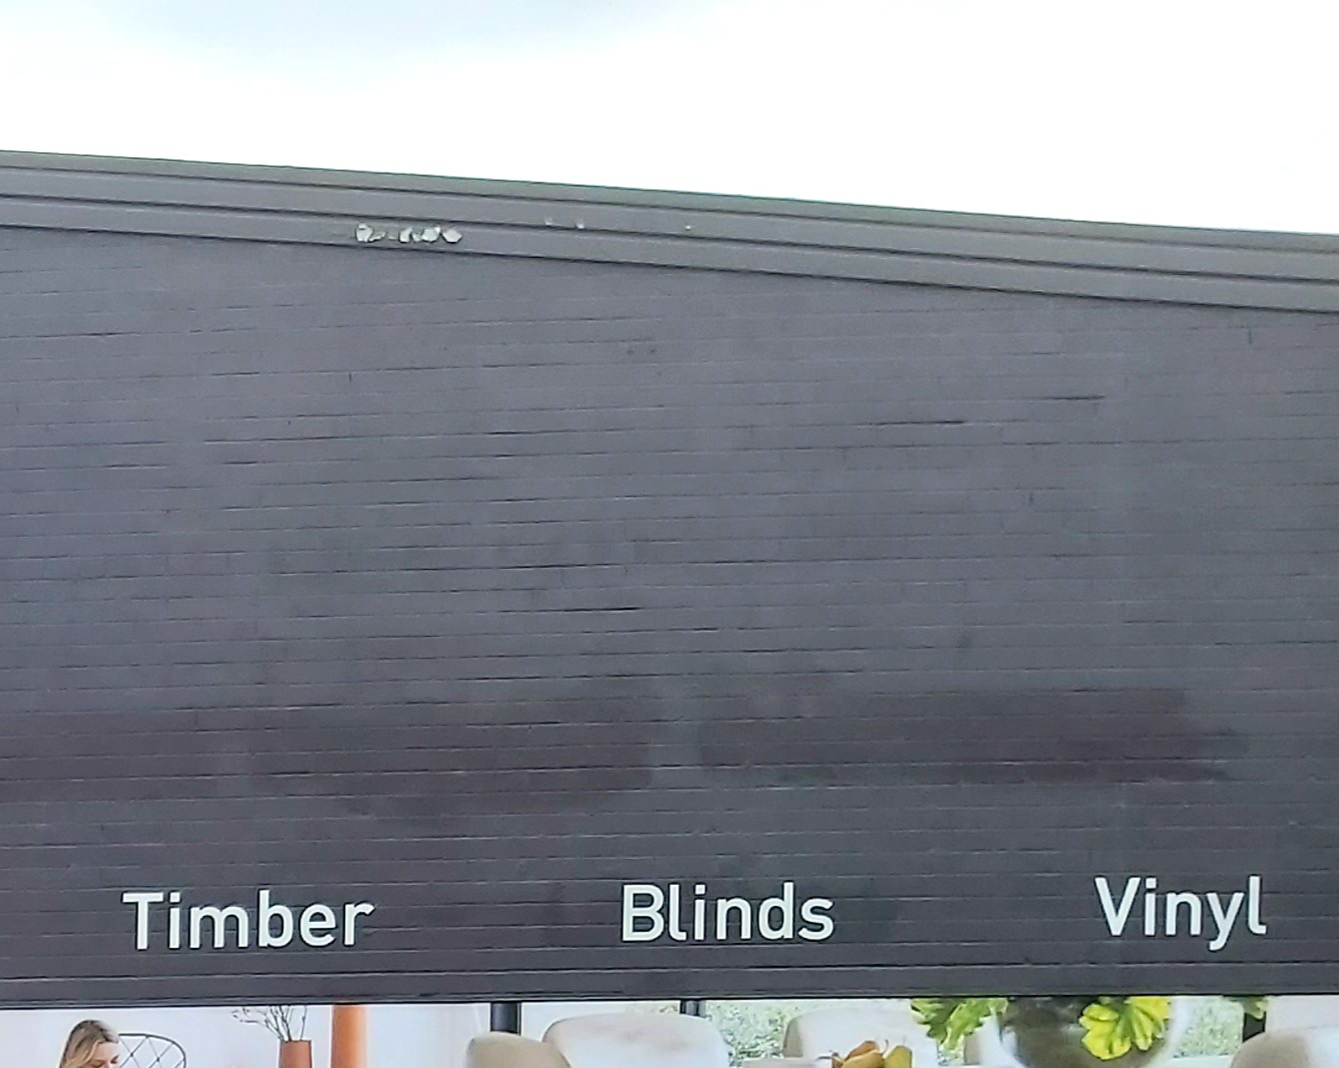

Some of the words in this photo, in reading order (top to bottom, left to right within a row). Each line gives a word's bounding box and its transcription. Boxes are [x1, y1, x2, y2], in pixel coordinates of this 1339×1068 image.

[123, 889, 375, 950] Timber
[622, 882, 834, 941] Blinds
[1094, 876, 1267, 951] Vinyl
